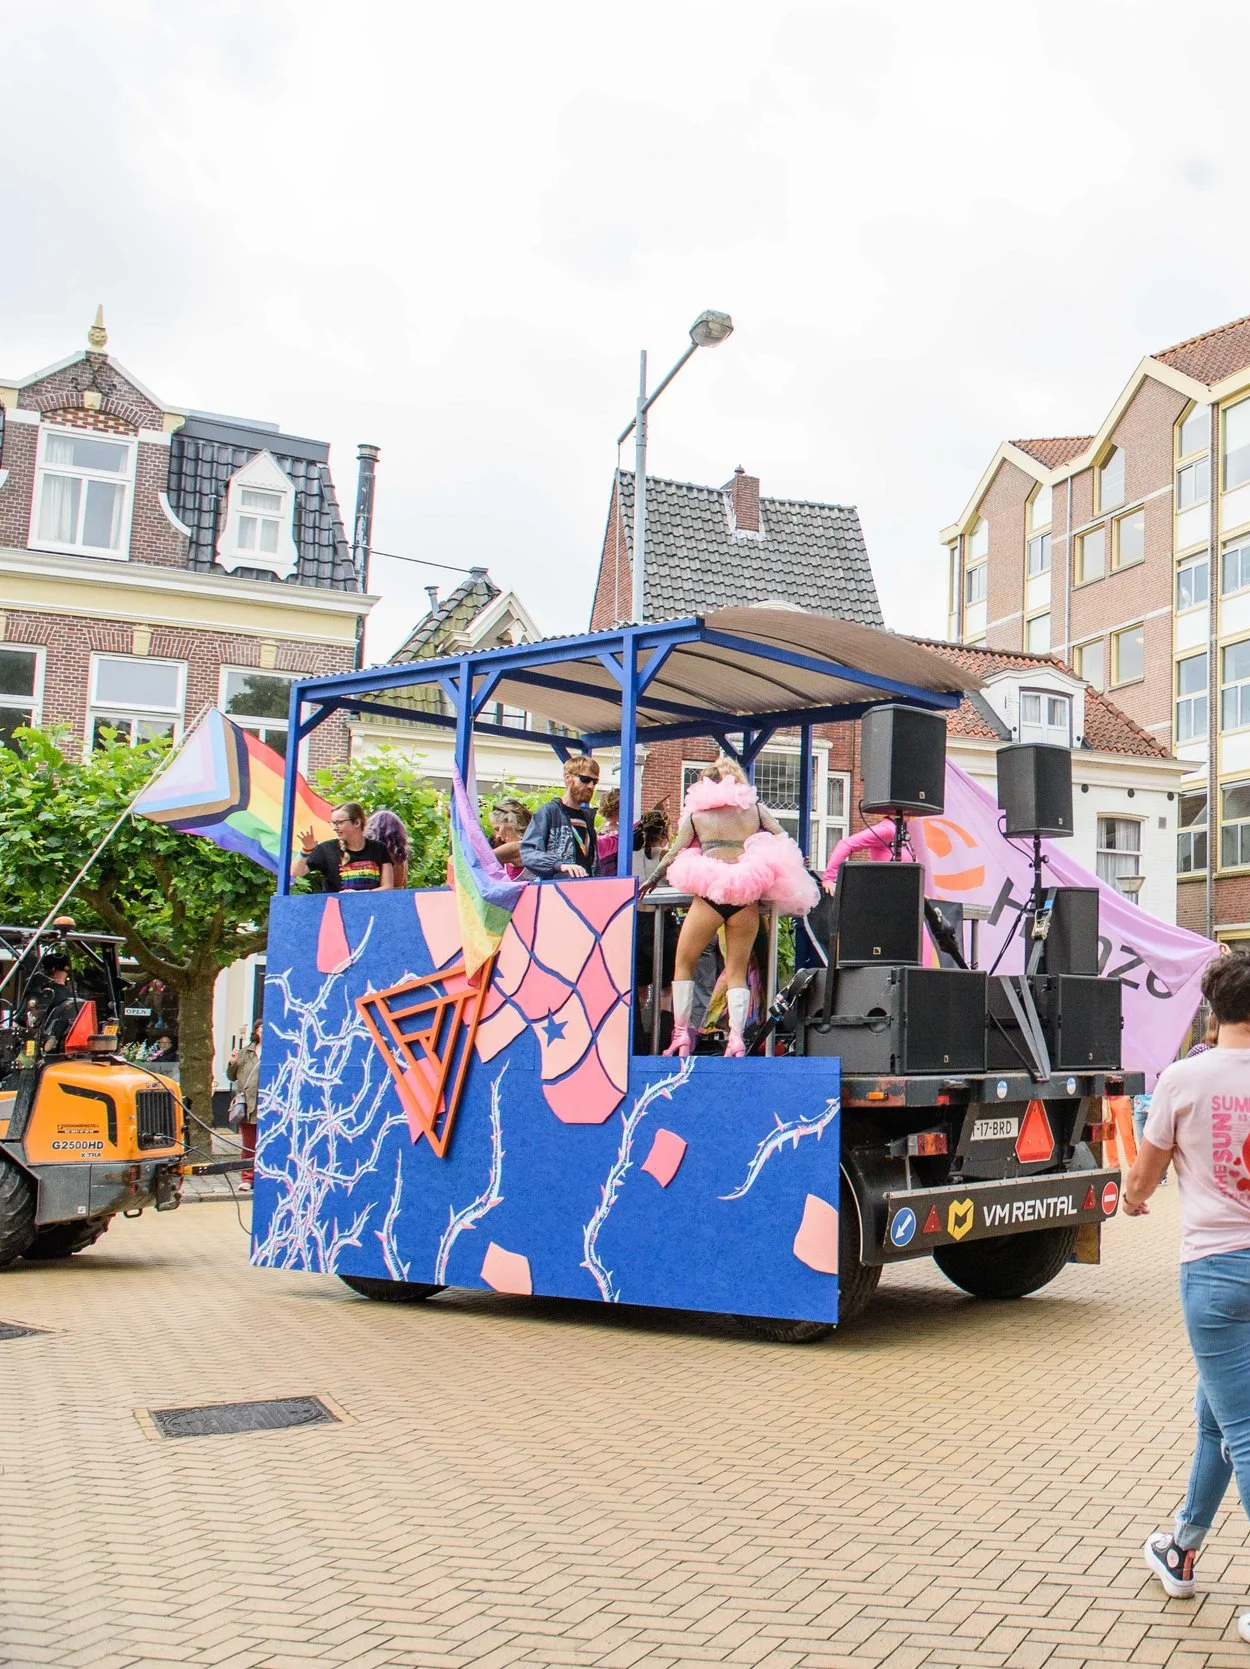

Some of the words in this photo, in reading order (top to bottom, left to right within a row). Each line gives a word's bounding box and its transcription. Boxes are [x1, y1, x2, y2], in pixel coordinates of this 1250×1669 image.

[52, 1141, 104, 1150] G2500HD
[1212, 1113, 1233, 1163] SUN
[1011, 1195, 1078, 1223] RENTAL
